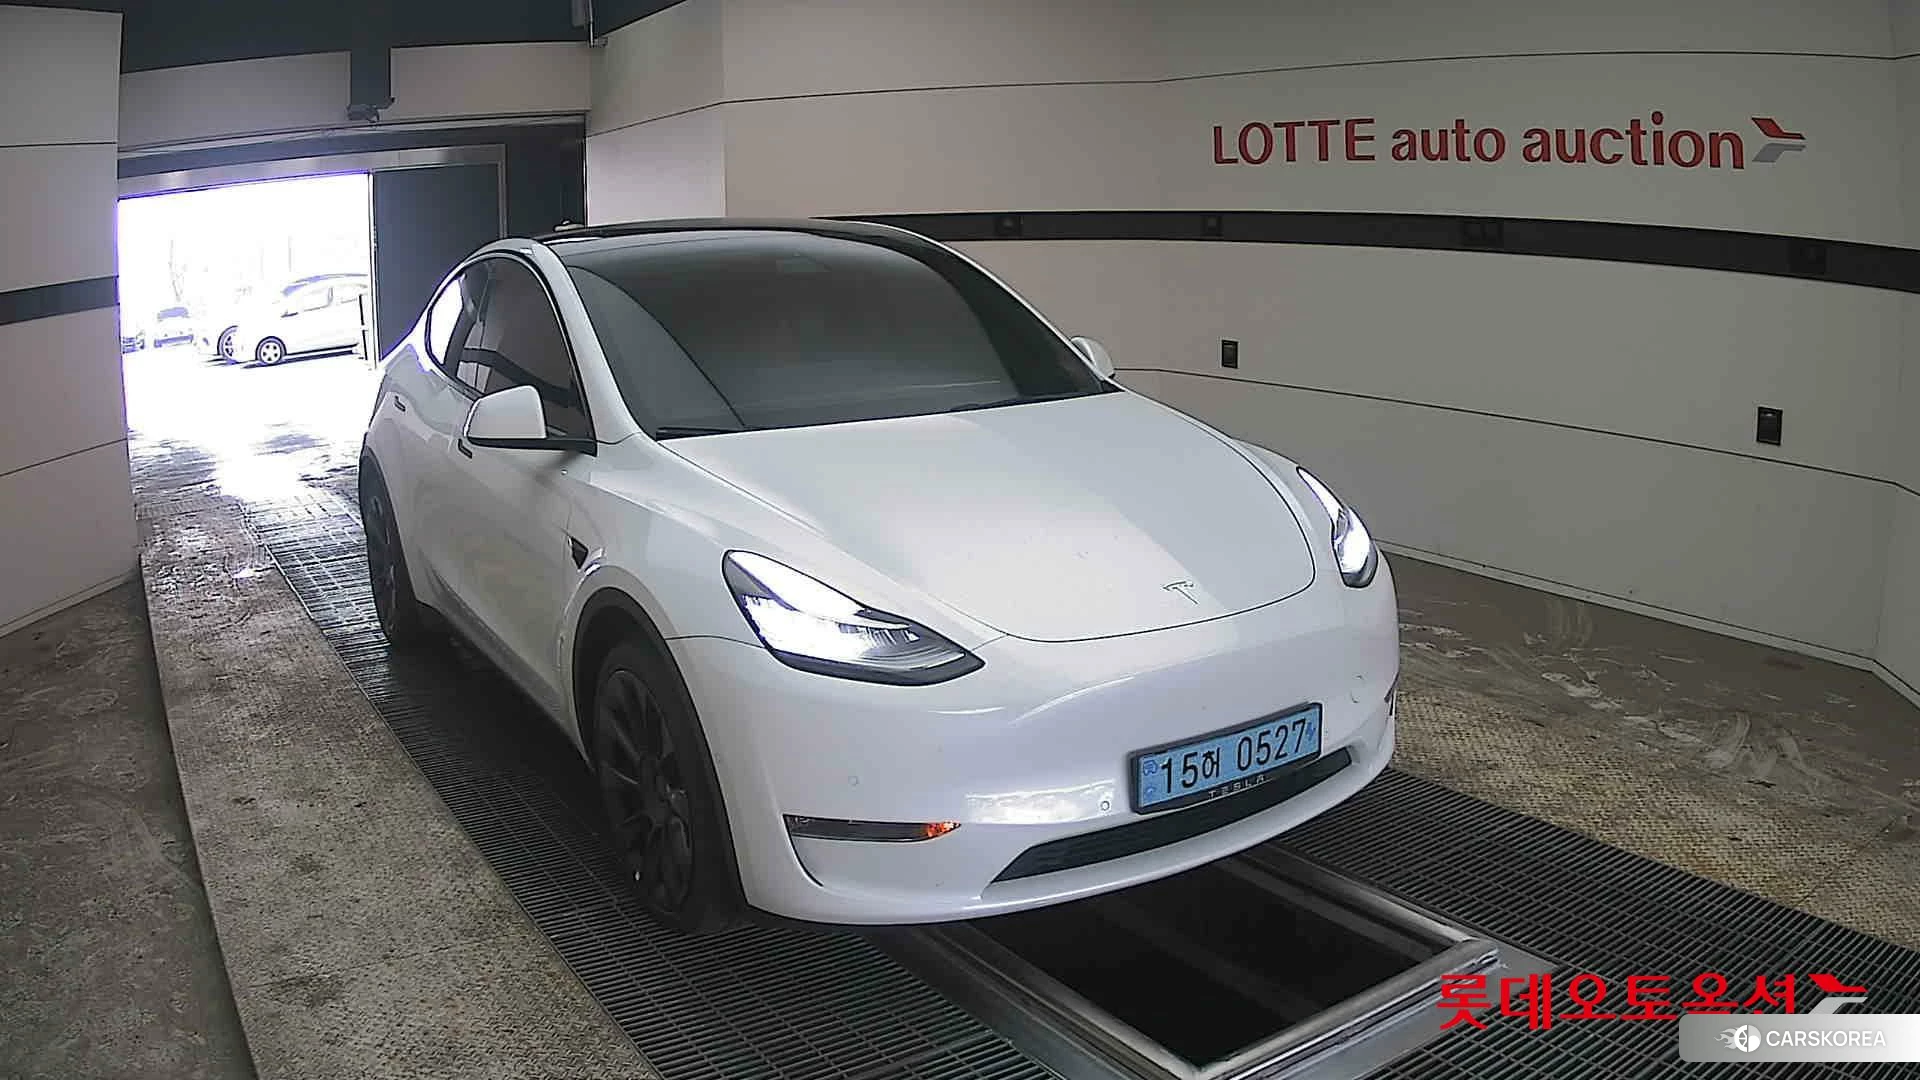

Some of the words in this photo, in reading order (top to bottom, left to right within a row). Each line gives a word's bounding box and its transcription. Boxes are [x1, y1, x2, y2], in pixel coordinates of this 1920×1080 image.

[1213, 118, 1376, 165] LOTTE
[1391, 118, 1506, 162] auto
[1522, 110, 1745, 170] auction
[1159, 747, 1221, 794] 15허
[1236, 718, 1308, 772] 0527
[1208, 774, 1265, 800] TESLA
